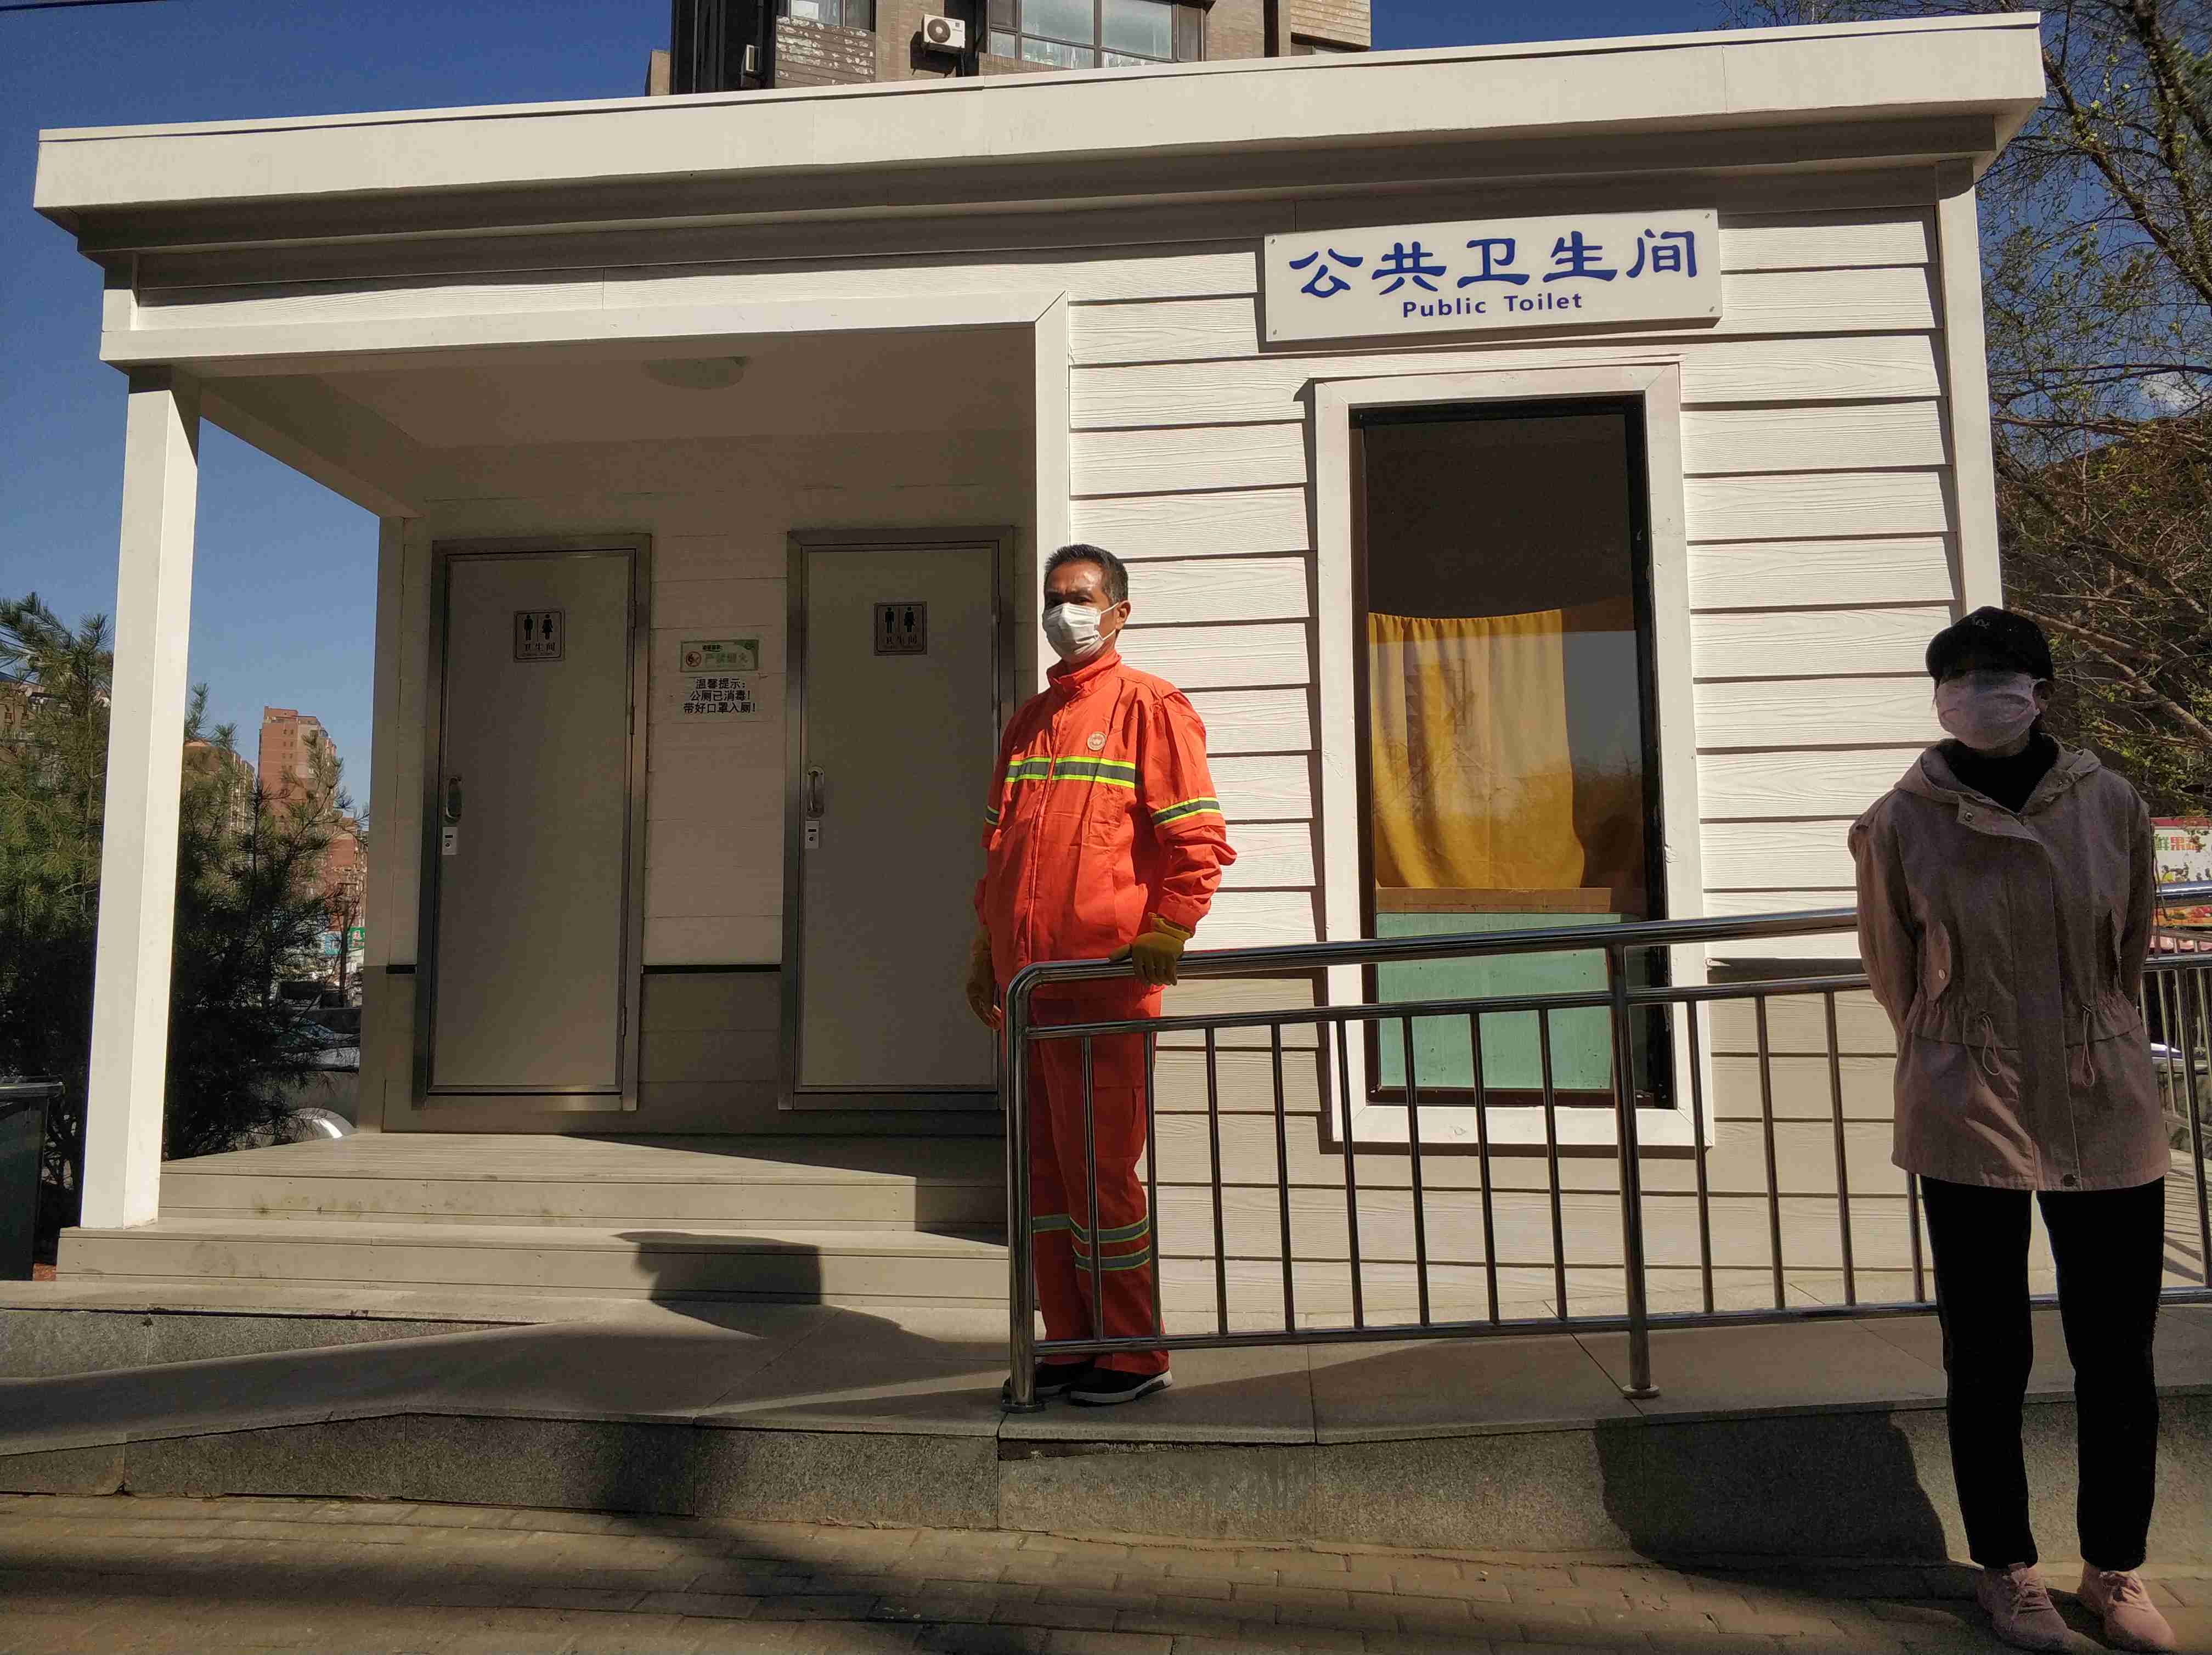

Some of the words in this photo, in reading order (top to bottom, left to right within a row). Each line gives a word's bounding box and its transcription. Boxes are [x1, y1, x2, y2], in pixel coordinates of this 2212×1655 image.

[1289, 228, 1698, 298] 公共卫生间
[1403, 298, 1486, 317] Public
[1504, 293, 1582, 313] Toilet
